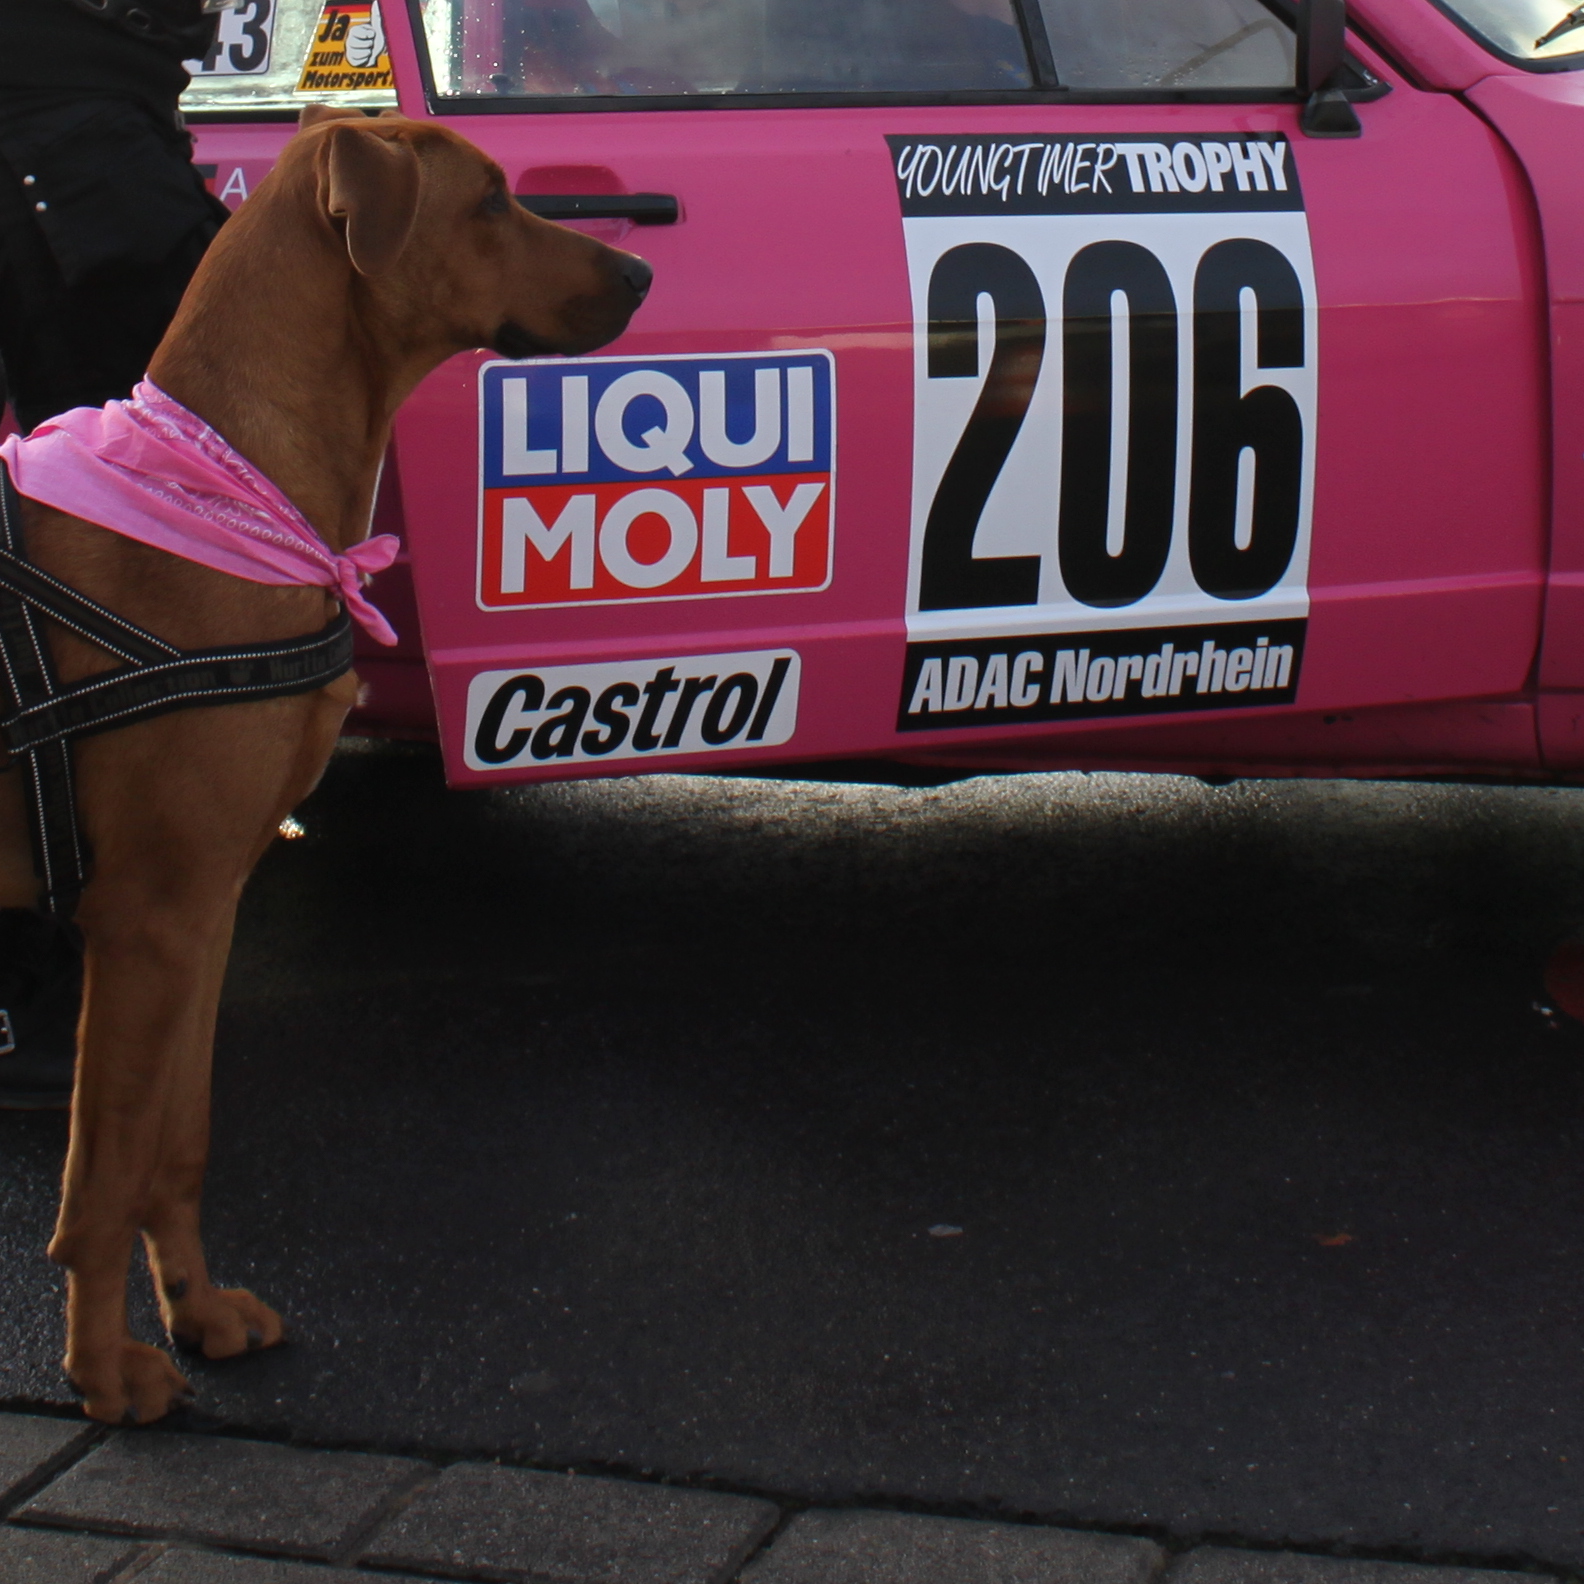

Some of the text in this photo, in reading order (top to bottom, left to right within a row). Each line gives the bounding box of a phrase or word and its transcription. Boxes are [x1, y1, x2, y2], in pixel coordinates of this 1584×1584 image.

[309, 51, 345, 67] zum
[318, 10, 350, 43] Ja
[501, 365, 815, 478] LIQUI
[918, 237, 1305, 612] 206
[498, 482, 827, 595] MOLY
[473, 656, 792, 766] Castrol
[910, 636, 1295, 714] ADAC Nordrhein
